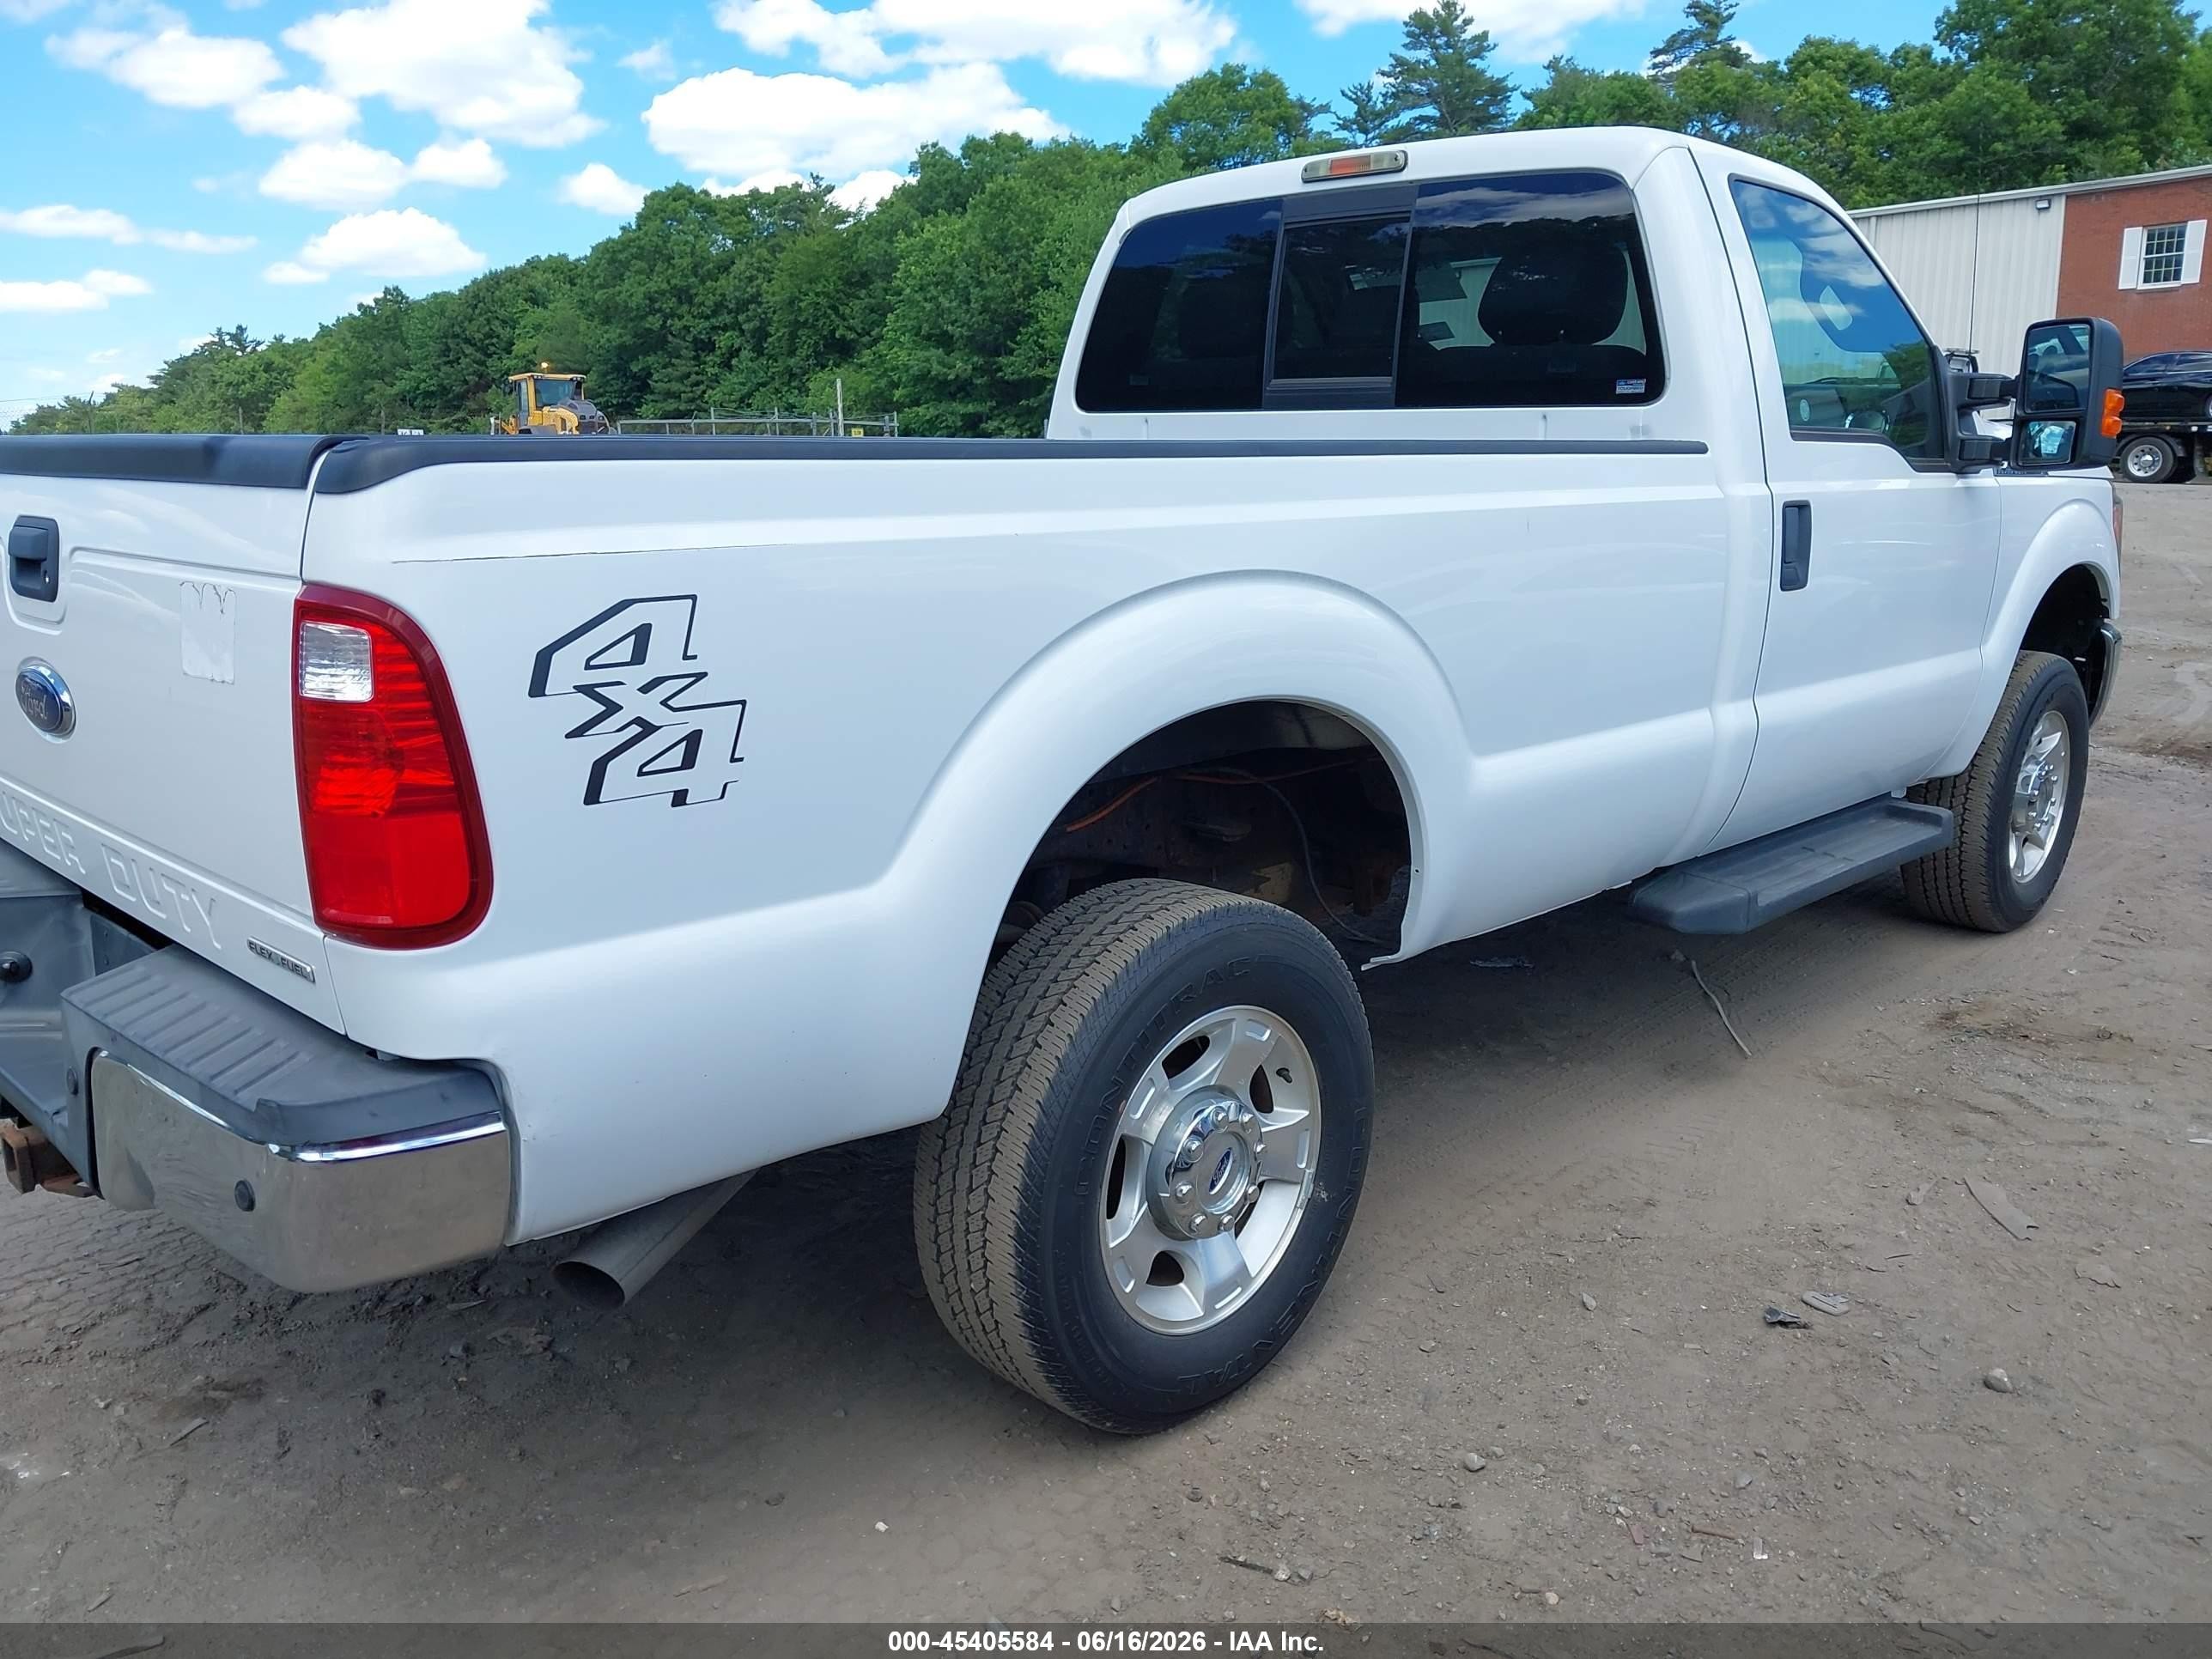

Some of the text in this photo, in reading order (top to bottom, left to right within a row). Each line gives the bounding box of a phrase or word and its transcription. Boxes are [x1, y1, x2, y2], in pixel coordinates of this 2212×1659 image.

[100, 842, 222, 951] DUTY
[247, 940, 311, 981] FLEX FUEL
